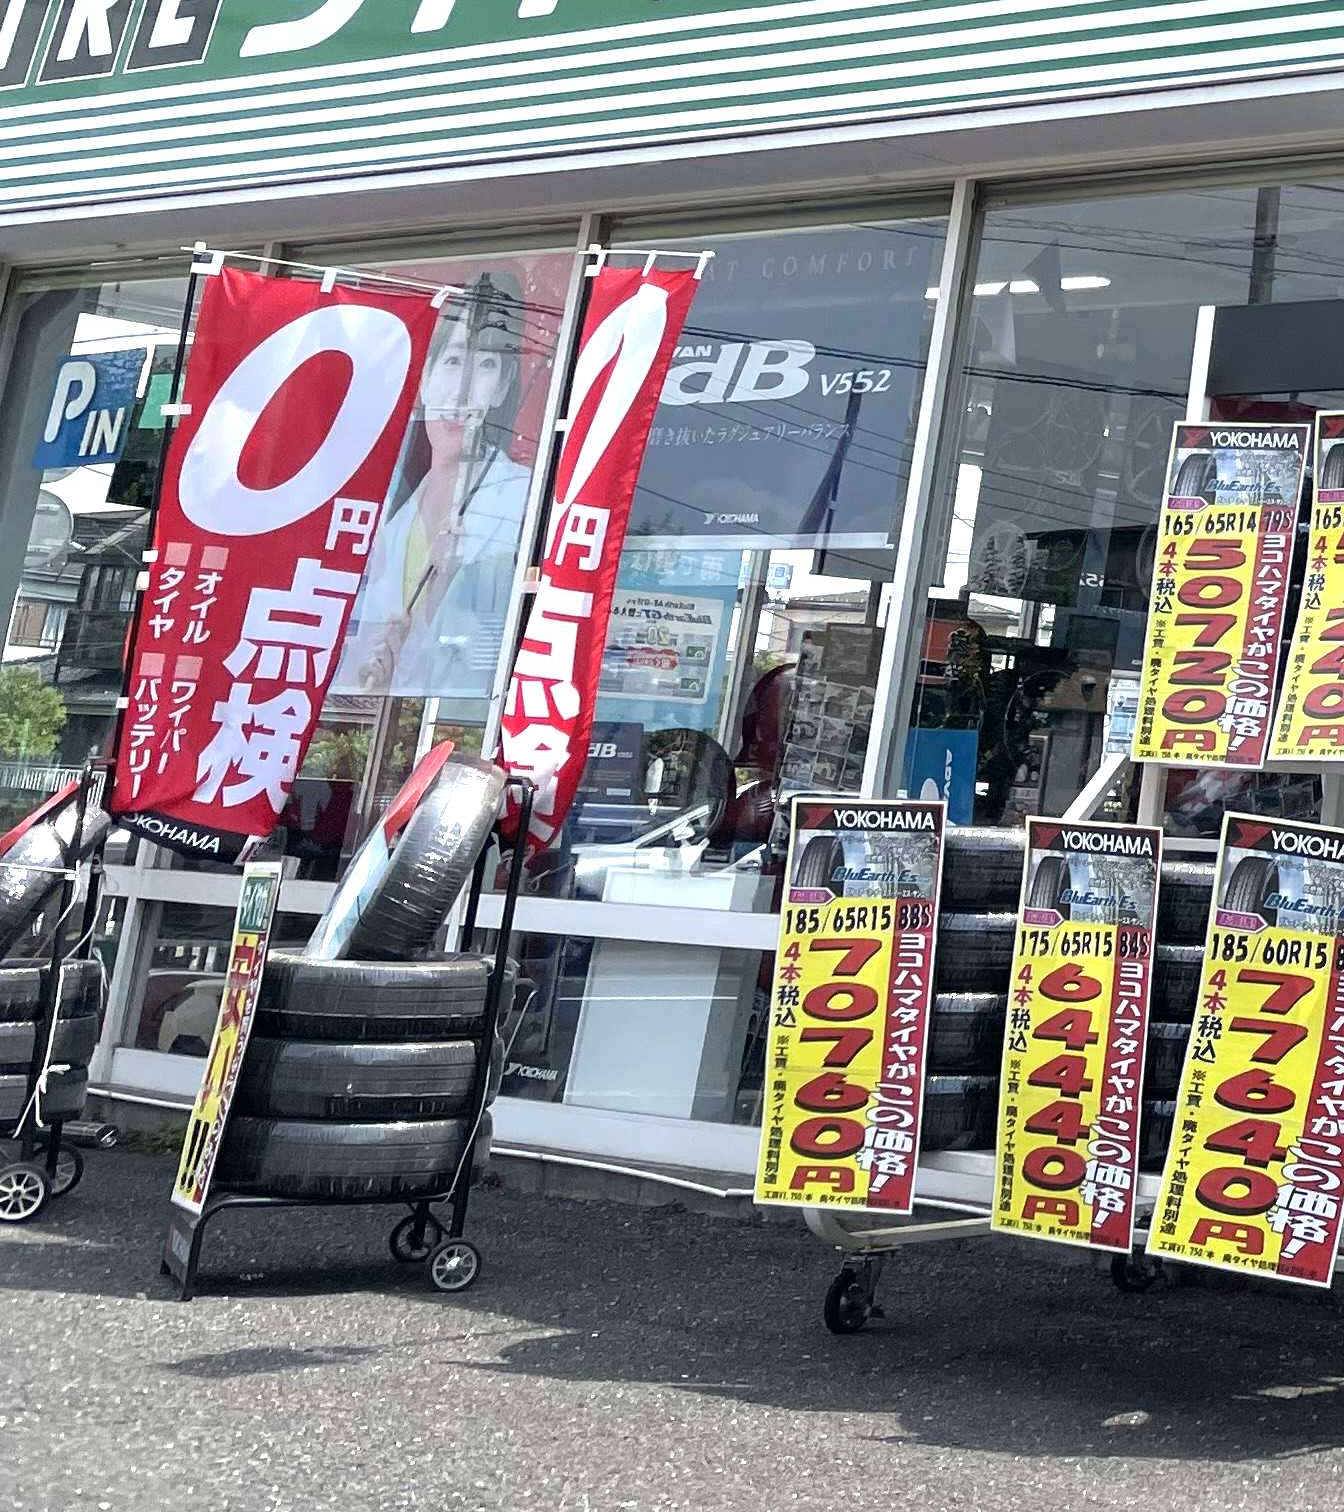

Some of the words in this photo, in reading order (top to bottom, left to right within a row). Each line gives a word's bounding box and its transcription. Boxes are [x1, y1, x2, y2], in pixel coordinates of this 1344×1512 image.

[820, 369, 892, 397] V552
[1210, 432, 1299, 448] YOKOHAMA
[1164, 511, 1257, 536] 165/65R14
[147, 568, 187, 639] タイヤ
[182, 572, 223, 645] オイル
[1154, 542, 1178, 614] 4本税込
[1304, 536, 1328, 610] 4本税込
[1160, 538, 1247, 752] 50720円
[127, 678, 161, 798] バッテリー
[157, 680, 198, 774] ワイパー
[833, 809, 935, 830] YOKOHAMA
[1062, 830, 1152, 855] YOKOHAMA
[785, 905, 891, 934] 185/65R15
[1019, 931, 1113, 957] 175/65R15
[1210, 933, 1328, 969] 185/60R15
[774, 942, 803, 1028] 4本税込
[1008, 964, 1034, 1052] 4本税込
[1191, 969, 1227, 1064] 4本税込
[789, 938, 883, 1193] 70760円
[1021, 962, 1103, 1227] 64440円
[1188, 969, 1315, 1256] 77640円
